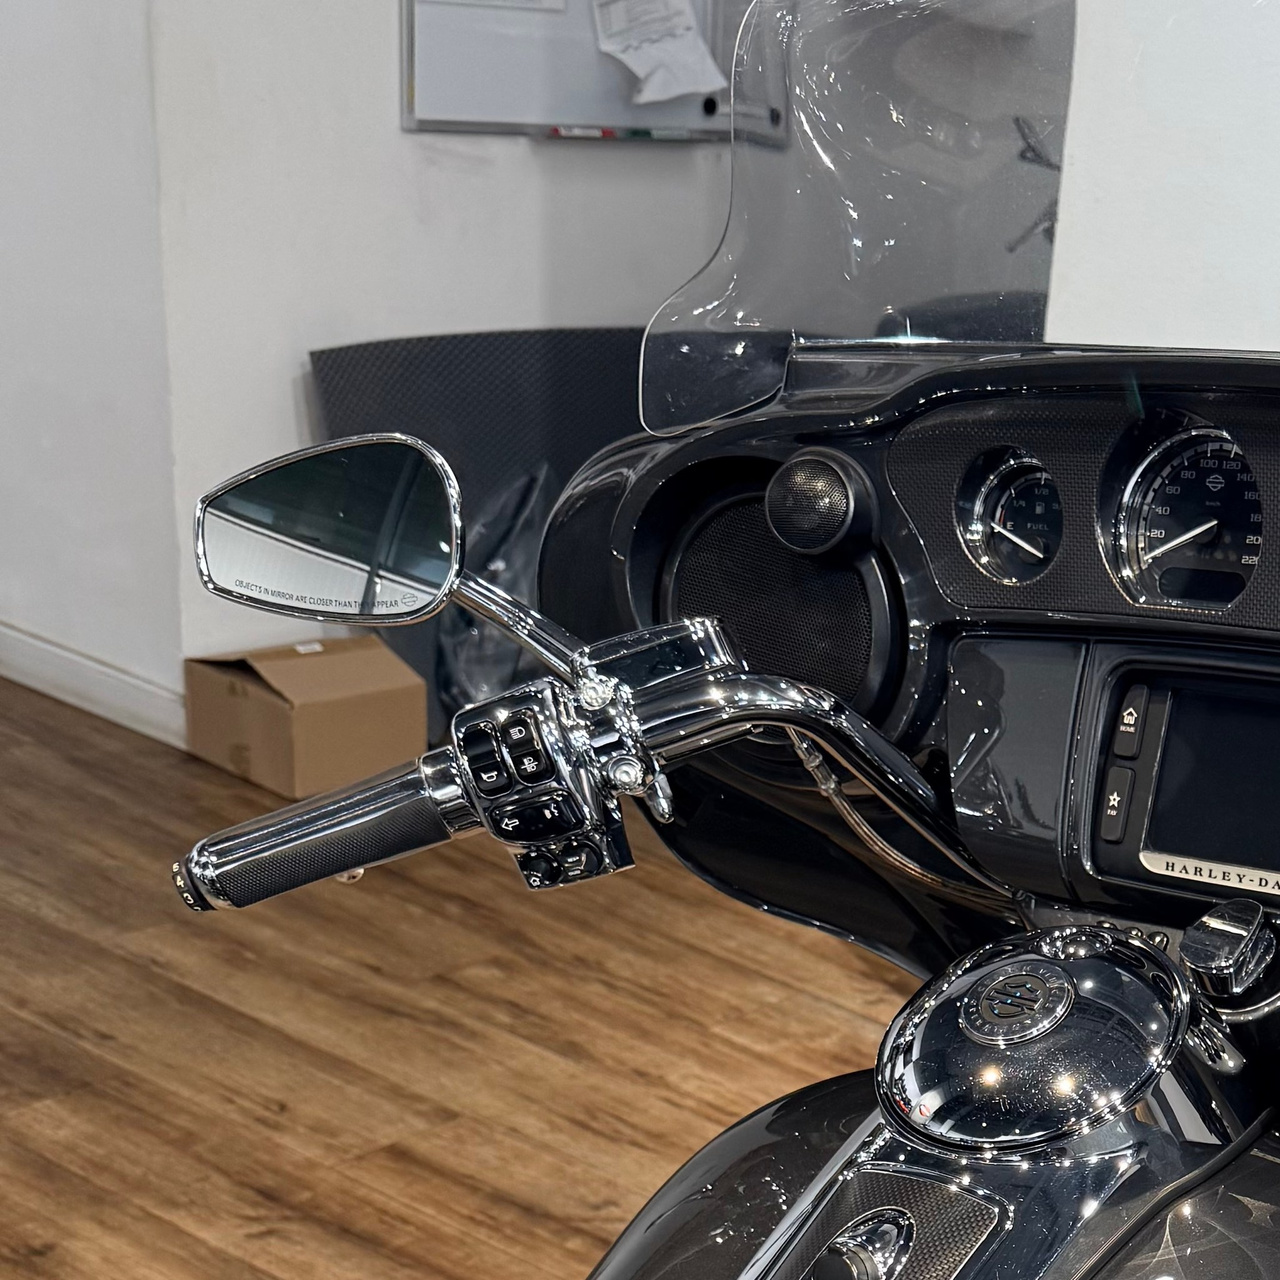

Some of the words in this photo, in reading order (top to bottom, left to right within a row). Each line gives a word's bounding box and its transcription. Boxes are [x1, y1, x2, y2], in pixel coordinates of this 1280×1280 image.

[1200, 459, 1218, 468] 100
[1222, 461, 1241, 469] 120
[1180, 471, 1196, 479] 80
[1236, 473, 1255, 481] 140
[1165, 486, 1180, 494] 60
[1155, 506, 1170, 515] 40
[1006, 522, 1014, 530] E
[1027, 522, 1049, 530] FUEL
[1150, 529, 1165, 538] 20
[234, 578, 262, 594] OBJECTS
[263, 587, 270, 596] IN
[270, 589, 294, 602] MIRROR
[295, 595, 307, 605] ARE
[308, 596, 333, 607] CLOSER
[334, 600, 353, 609] THAN
[176, 875, 184, 888] 4
